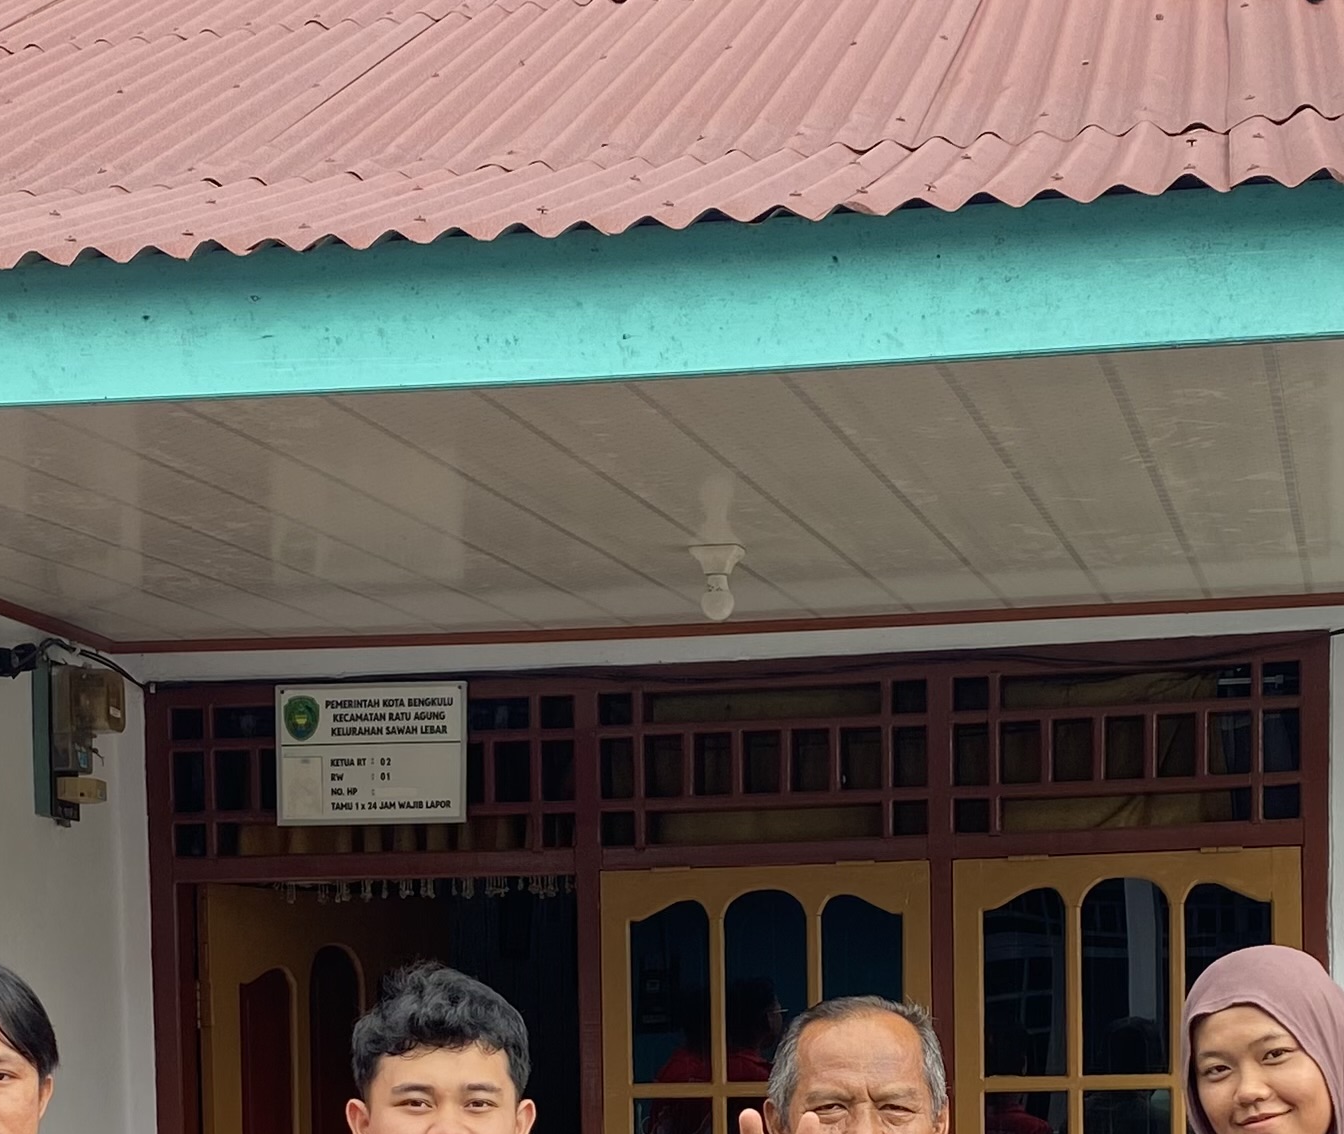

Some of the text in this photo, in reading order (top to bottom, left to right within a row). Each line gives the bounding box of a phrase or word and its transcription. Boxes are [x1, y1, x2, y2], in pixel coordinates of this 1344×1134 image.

[325, 697, 454, 709] PEMERINTAH KOTA BENGKULU
[333, 711, 446, 723] KECAMATAN RATU AGUNG
[331, 724, 448, 737] KELURAHAN SAWAH LEBAR
[330, 758, 355, 767] KETUA
[357, 758, 367, 766] RT
[380, 757, 391, 766] 02
[330, 773, 344, 781] RW
[380, 772, 391, 780] 01
[331, 788, 344, 796] NO.
[347, 787, 358, 796] HP
[331, 802, 353, 811] TAMU
[355, 802, 359, 810] 1
[367, 802, 377, 810] 24
[379, 801, 396, 810] JAM
[398, 800, 423, 809] WAJIB
[425, 800, 451, 809] LAPOR
